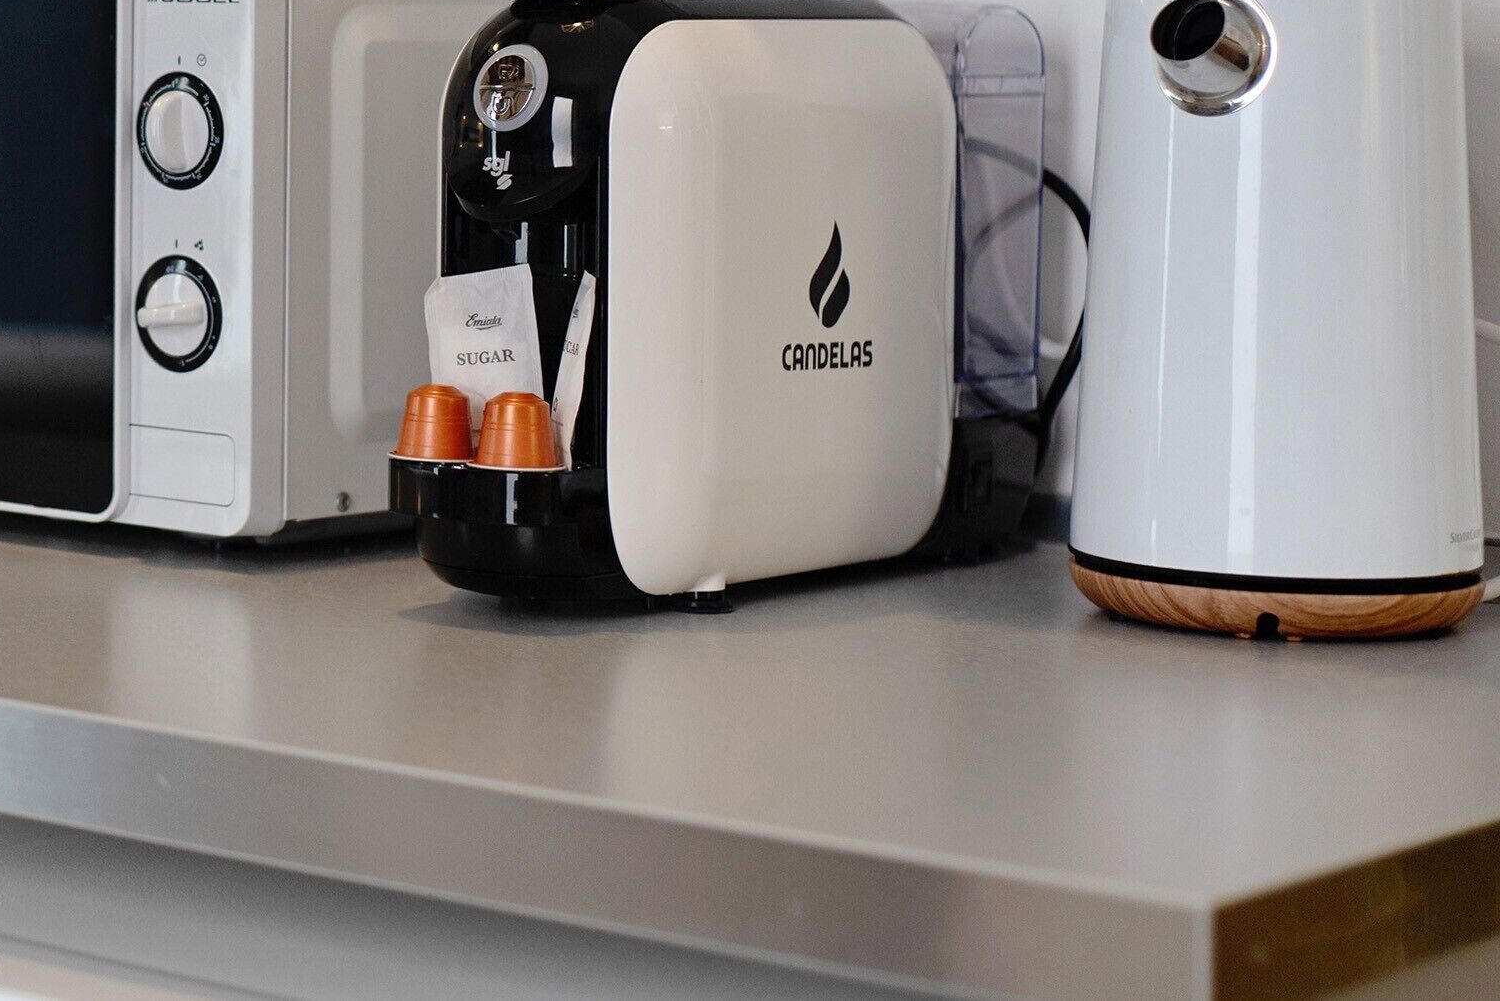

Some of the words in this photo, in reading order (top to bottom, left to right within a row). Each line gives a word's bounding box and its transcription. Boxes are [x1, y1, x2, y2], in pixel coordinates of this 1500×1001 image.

[482, 150, 511, 177] sgl
[456, 348, 516, 366] SUGAR
[782, 340, 874, 371] CANDELAS
